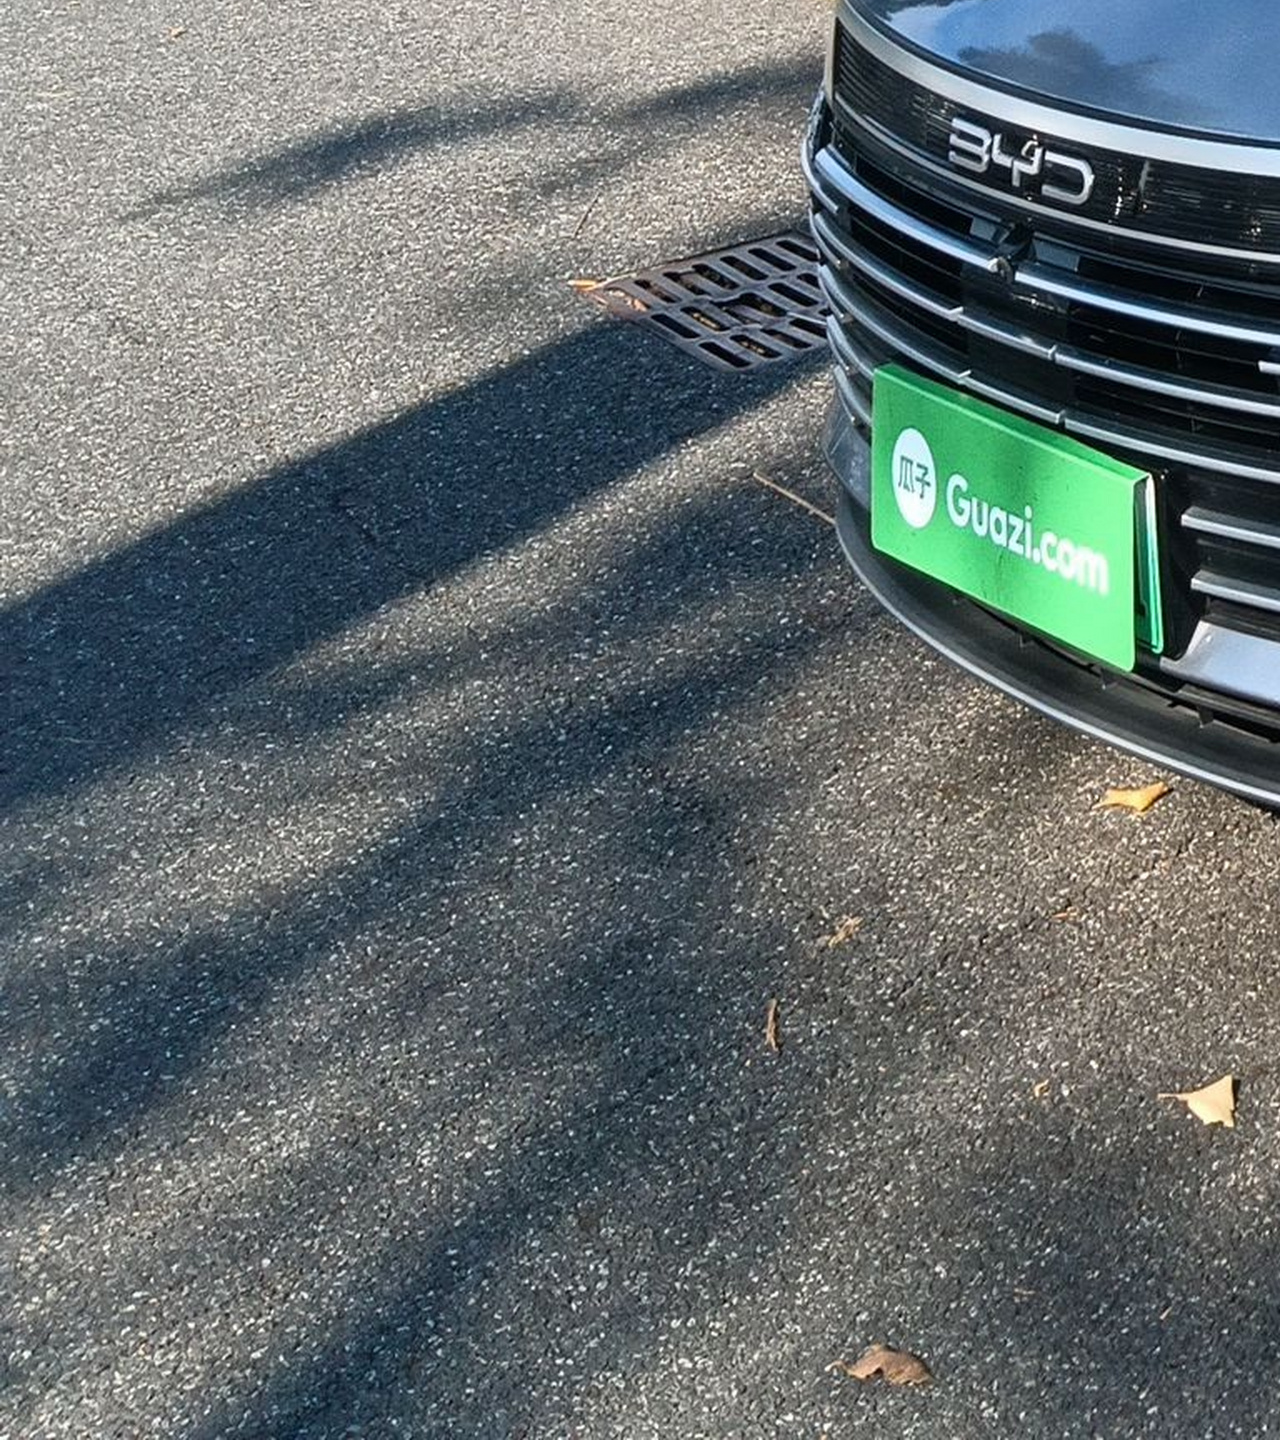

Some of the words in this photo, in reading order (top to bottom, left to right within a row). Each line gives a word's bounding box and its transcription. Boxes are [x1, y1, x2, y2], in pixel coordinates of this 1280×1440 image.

[949, 118, 1093, 204] BYD
[898, 455, 931, 499] 瓜子
[946, 474, 1109, 596] Guazi.com
